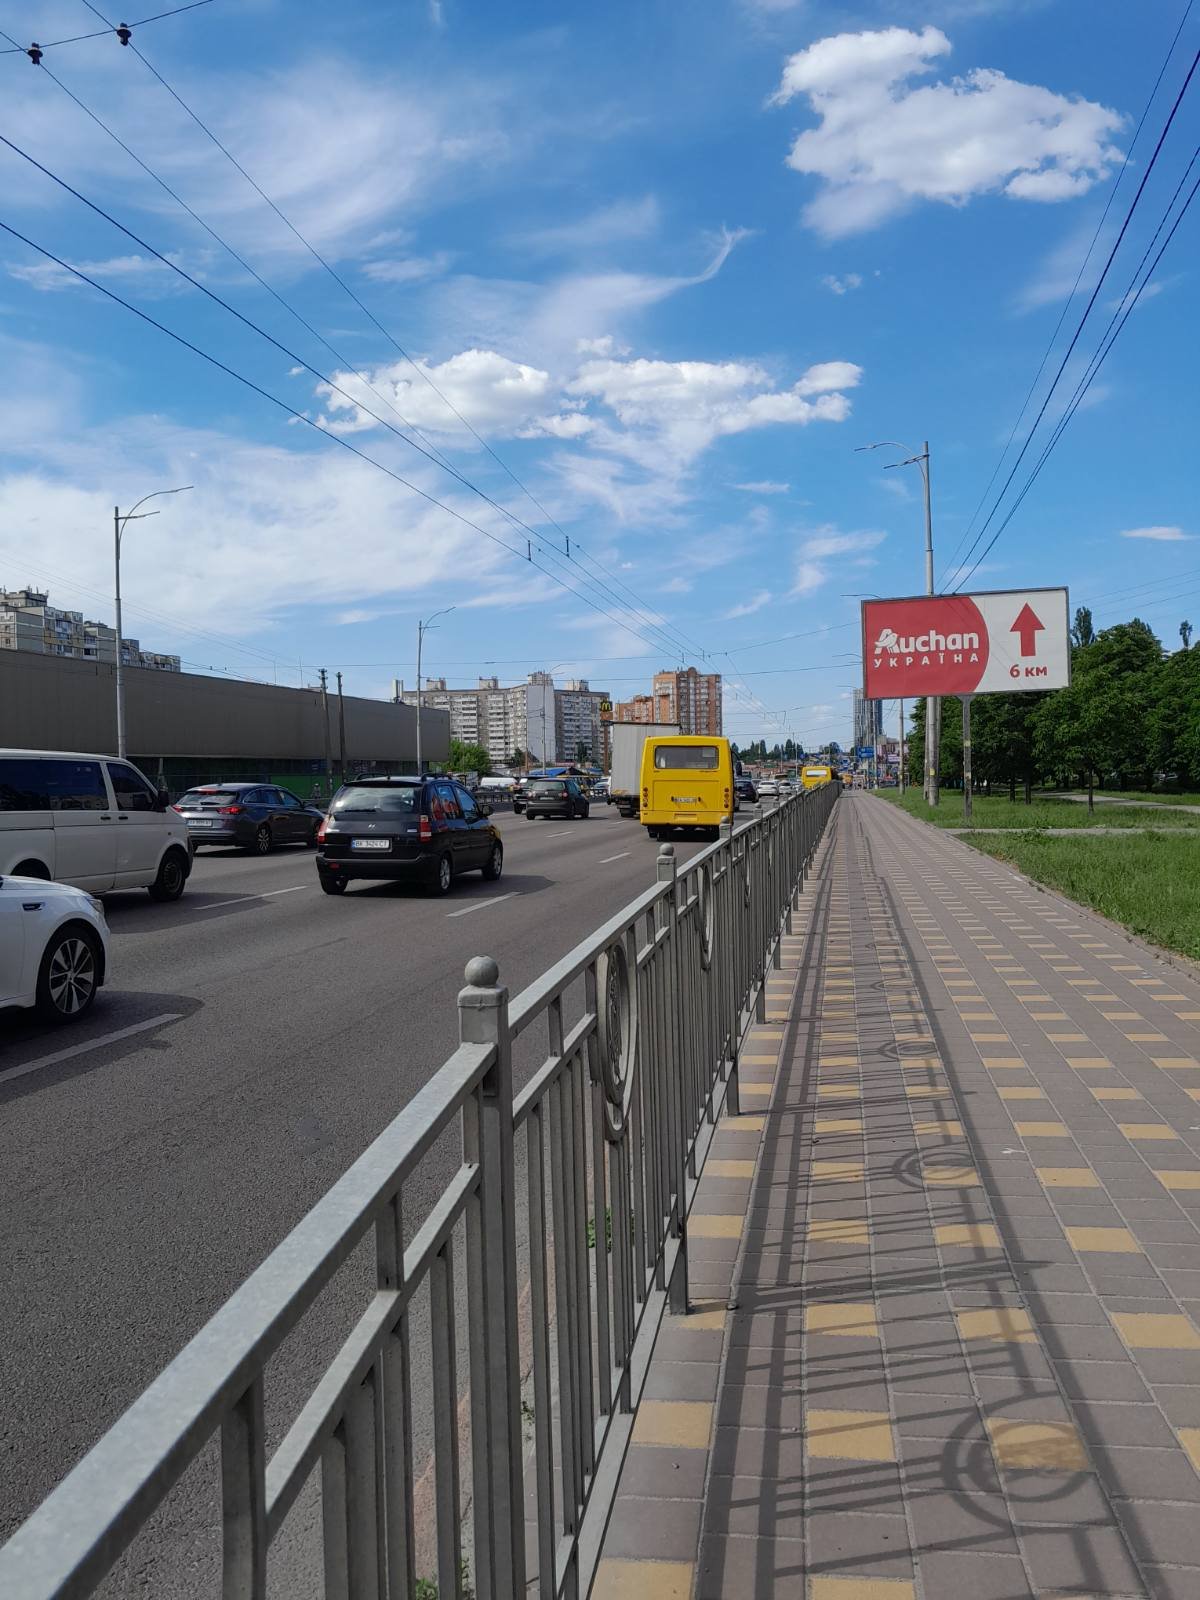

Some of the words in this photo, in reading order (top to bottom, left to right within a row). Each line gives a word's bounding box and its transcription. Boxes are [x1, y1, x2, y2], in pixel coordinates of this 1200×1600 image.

[874, 628, 979, 654] Auchan
[874, 652, 979, 668] УКРАЇНА
[1010, 664, 1020, 678] 6
